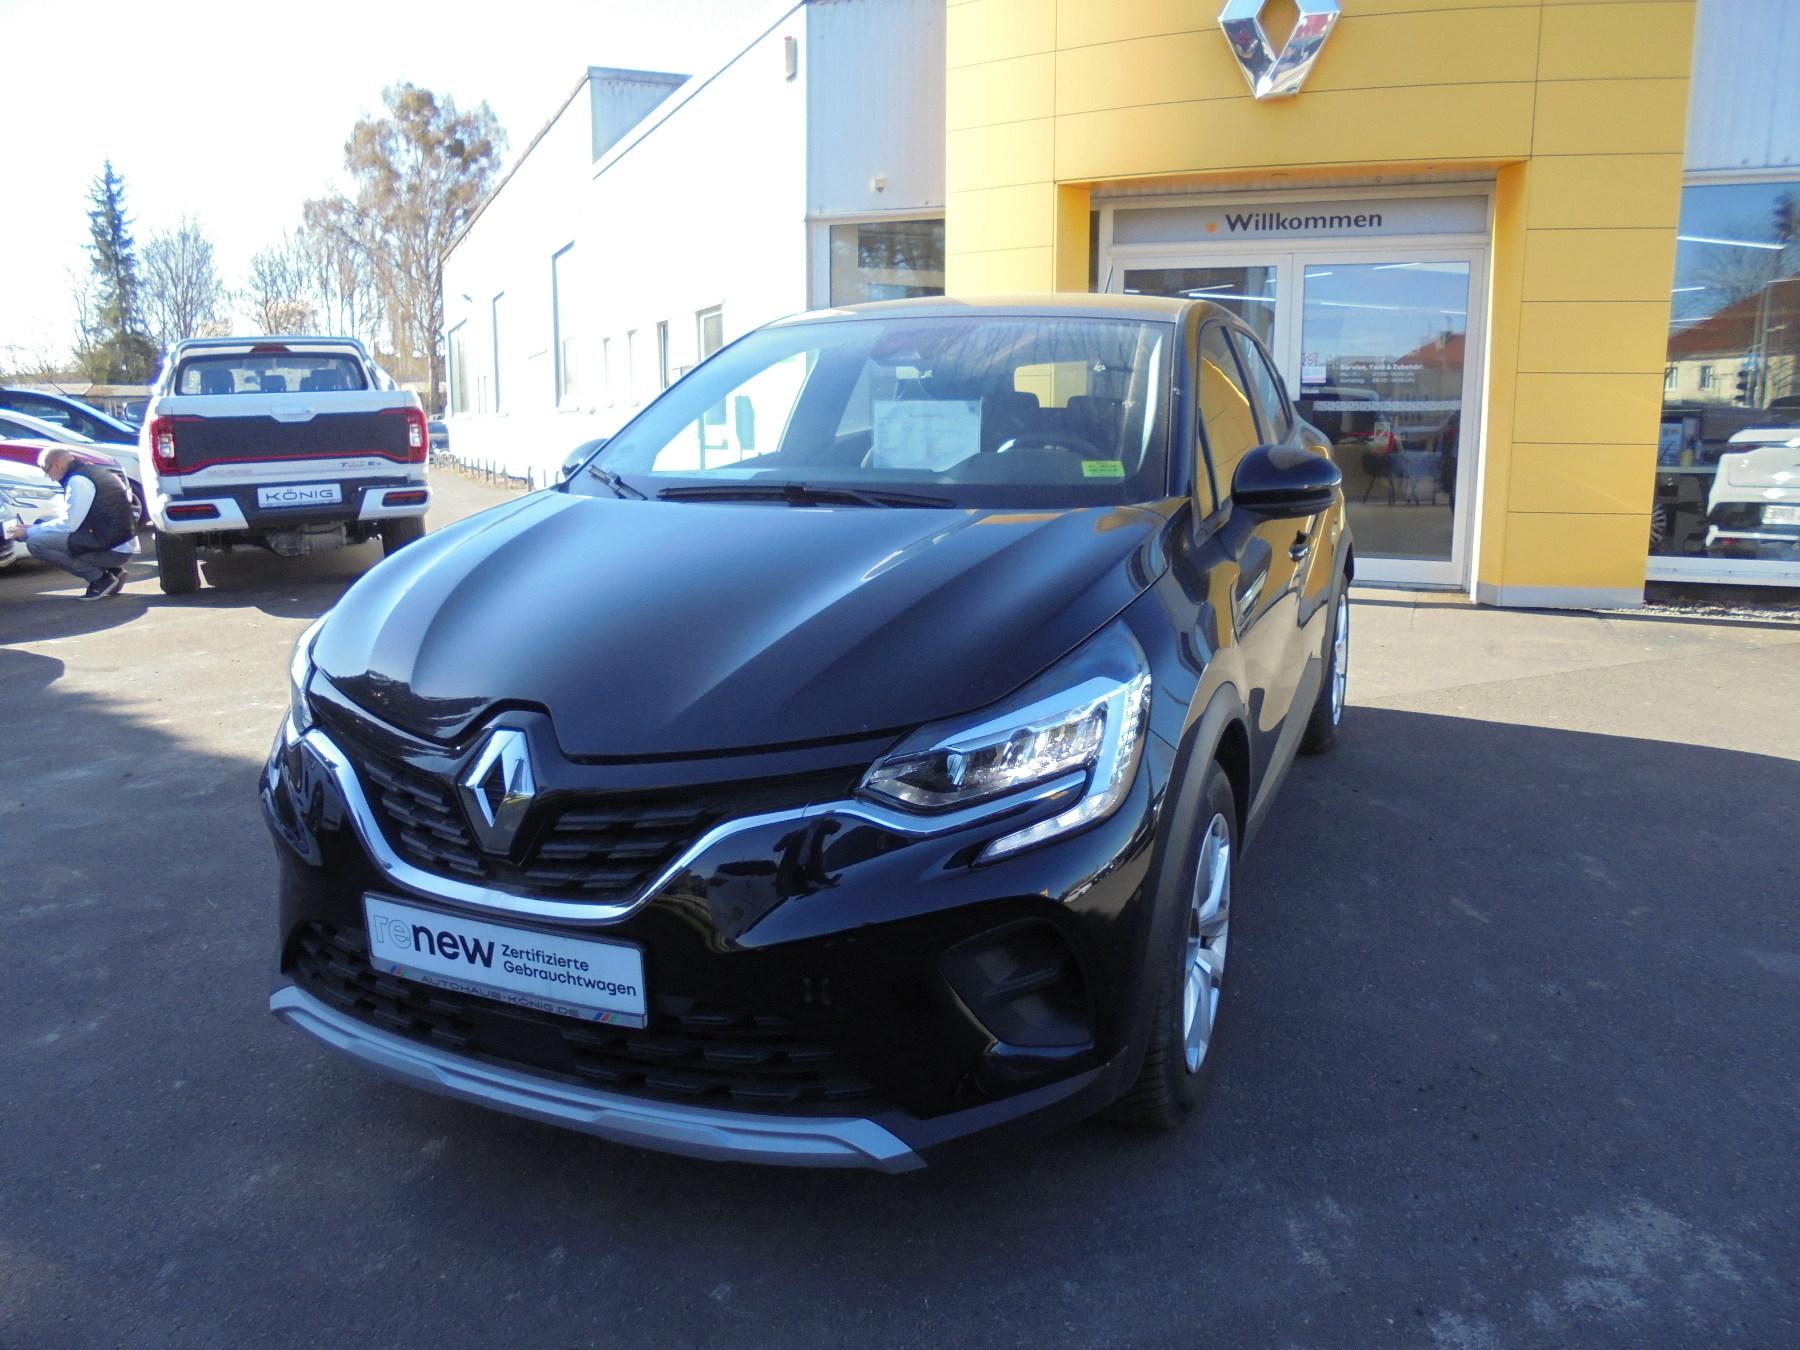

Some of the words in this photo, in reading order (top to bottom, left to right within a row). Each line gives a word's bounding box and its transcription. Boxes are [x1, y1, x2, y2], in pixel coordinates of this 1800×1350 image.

[1224, 212, 1382, 232] Willkommen
[266, 487, 333, 501] KÖNIG
[373, 914, 495, 969] renew
[501, 943, 589, 972] Zertifizierte
[503, 960, 637, 997] Gebrauchtwagen
